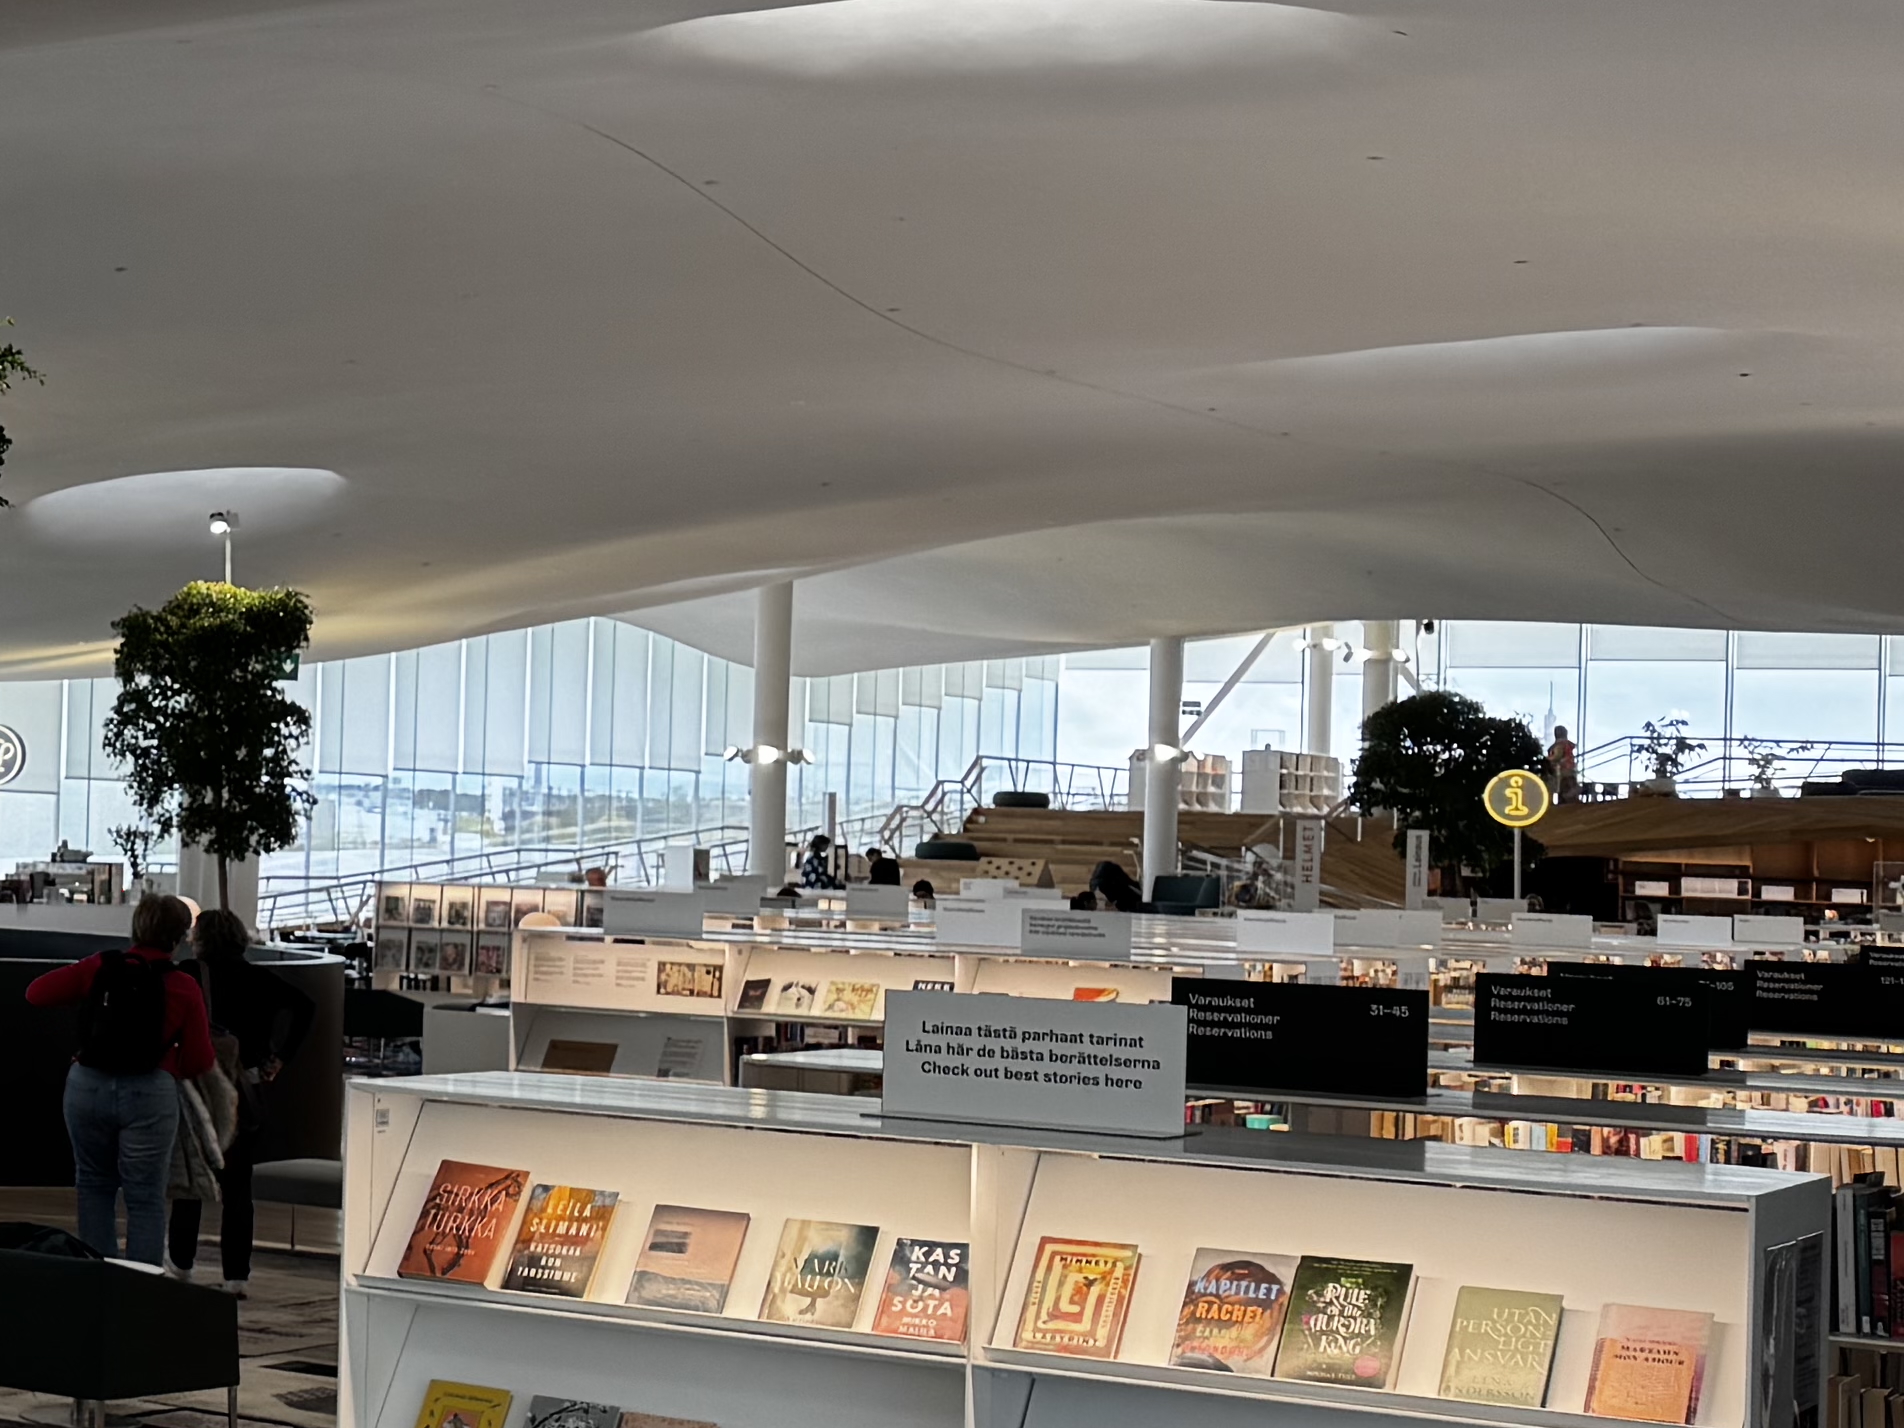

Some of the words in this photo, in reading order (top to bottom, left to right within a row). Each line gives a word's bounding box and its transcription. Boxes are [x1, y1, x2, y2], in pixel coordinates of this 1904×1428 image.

[1302, 826, 1314, 883] HELMET
[1757, 970, 1805, 980] Varaukset
[1189, 993, 1254, 1008] Varaukset
[1491, 985, 1552, 999] Varaukset
[1491, 998, 1576, 1013] Reservationer
[1189, 1009, 1280, 1025] Reservationer
[1491, 1011, 1569, 1025] Reservations
[921, 1021, 973, 1038] Lainaa
[977, 1023, 1017, 1041] tästä
[1021, 1027, 1084, 1049] parhaat
[1088, 1031, 1144, 1049] tarinat
[1189, 1024, 1273, 1039] Reservations
[905, 1039, 942, 1055] Låna
[946, 1041, 973, 1058] här
[976, 1044, 995, 1059] de
[1000, 1045, 1044, 1063] bästa
[1049, 1048, 1160, 1070] berättelserna
[921, 1060, 969, 1078] Check
[974, 1064, 999, 1080] out
[1004, 1064, 1039, 1082] best
[1043, 1068, 1100, 1087] stories
[1104, 1073, 1142, 1090] here
[437, 1183, 507, 1212] SIRKKA
[547, 1198, 592, 1217] LEILA
[425, 1209, 497, 1239] TURKKA
[530, 1218, 597, 1238] SLIMANI
[911, 1246, 961, 1264] KAS
[909, 1263, 956, 1282] TAN
[912, 1284, 940, 1298] JA
[1195, 1276, 1280, 1300] KAPITLET
[892, 1296, 951, 1316] SOTA
[1196, 1302, 1263, 1324] RACHEL
[1493, 1307, 1556, 1325] UTAN
[1450, 1348, 1546, 1374] ANSVAR
